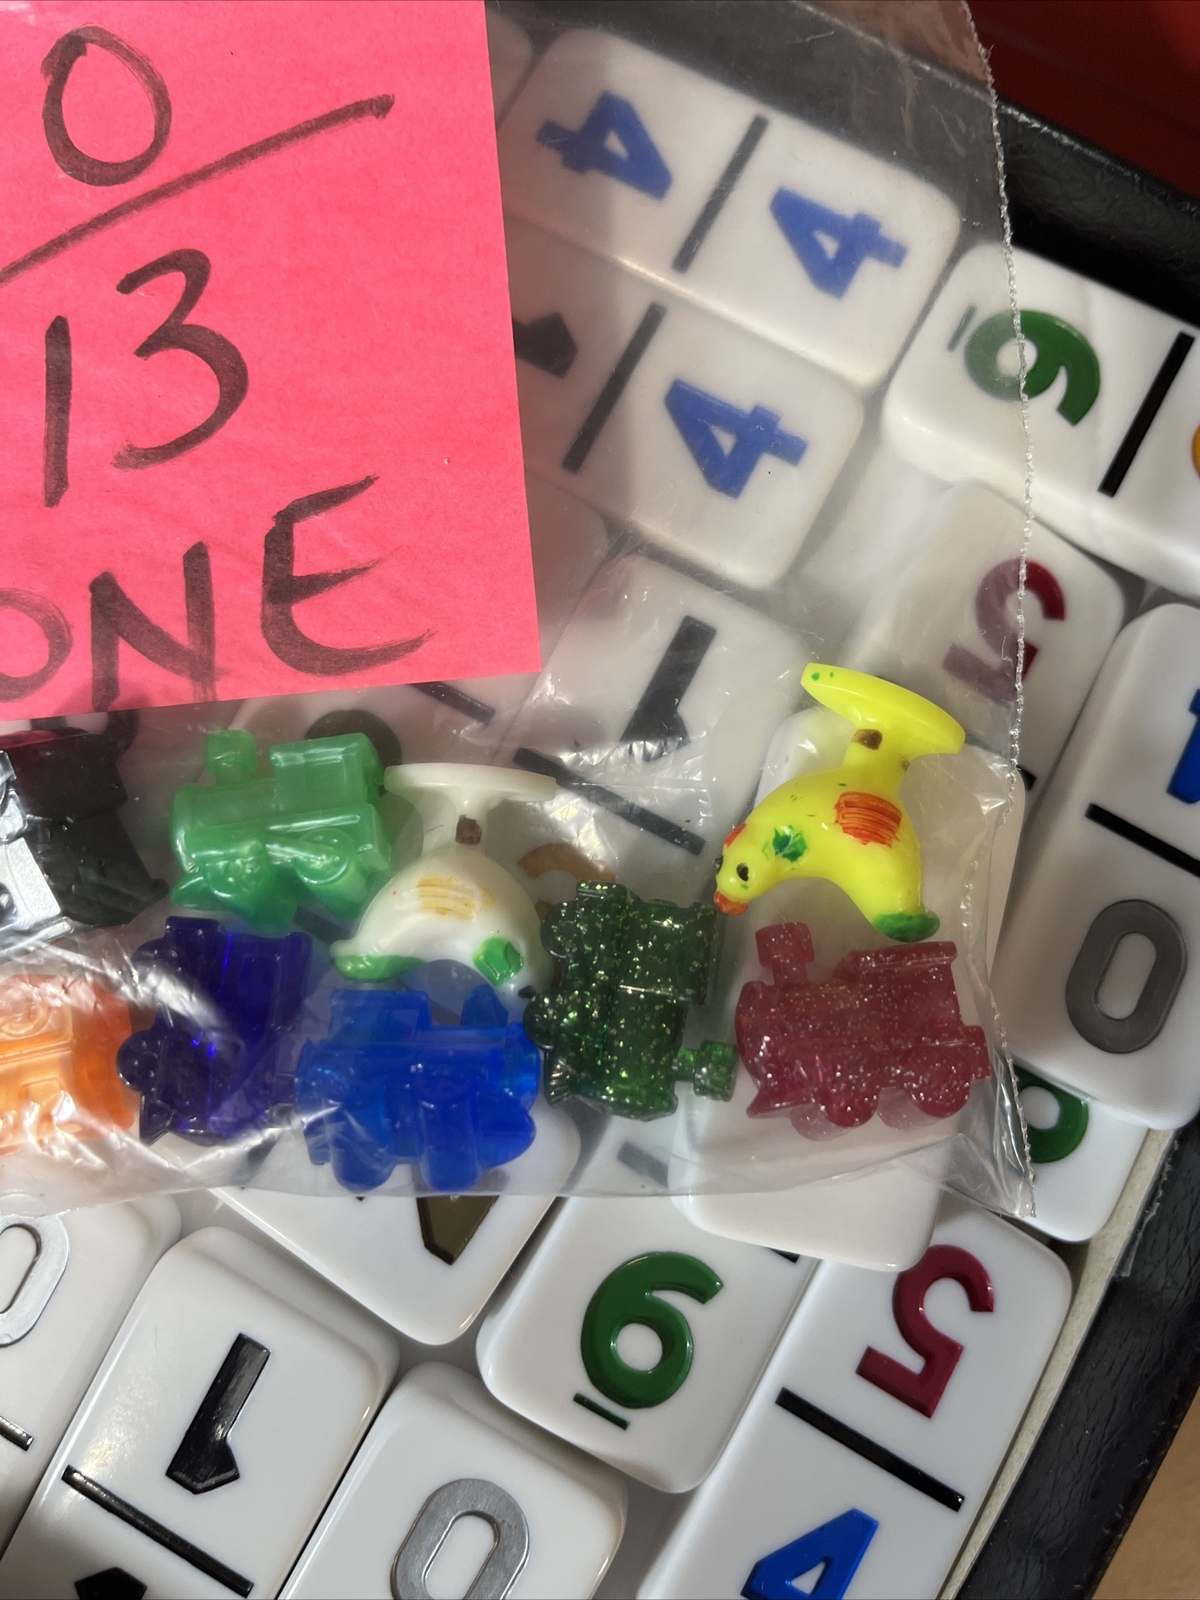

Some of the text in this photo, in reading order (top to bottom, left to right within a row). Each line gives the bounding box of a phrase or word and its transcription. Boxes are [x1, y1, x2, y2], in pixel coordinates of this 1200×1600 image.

[42, 24, 172, 187] 0
[536, 90, 673, 201] 4
[769, 186, 908, 298] 4
[44, 247, 249, 508] 13
[663, 378, 808, 500] 4
[963, 308, 1101, 427] 6
[619, 615, 717, 762] 1
[942, 556, 1066, 703] 5
[1065, 899, 1187, 1054] 0
[580, 1250, 724, 1410] 6
[855, 1244, 994, 1419] 5
[165, 1332, 271, 1495] 1
